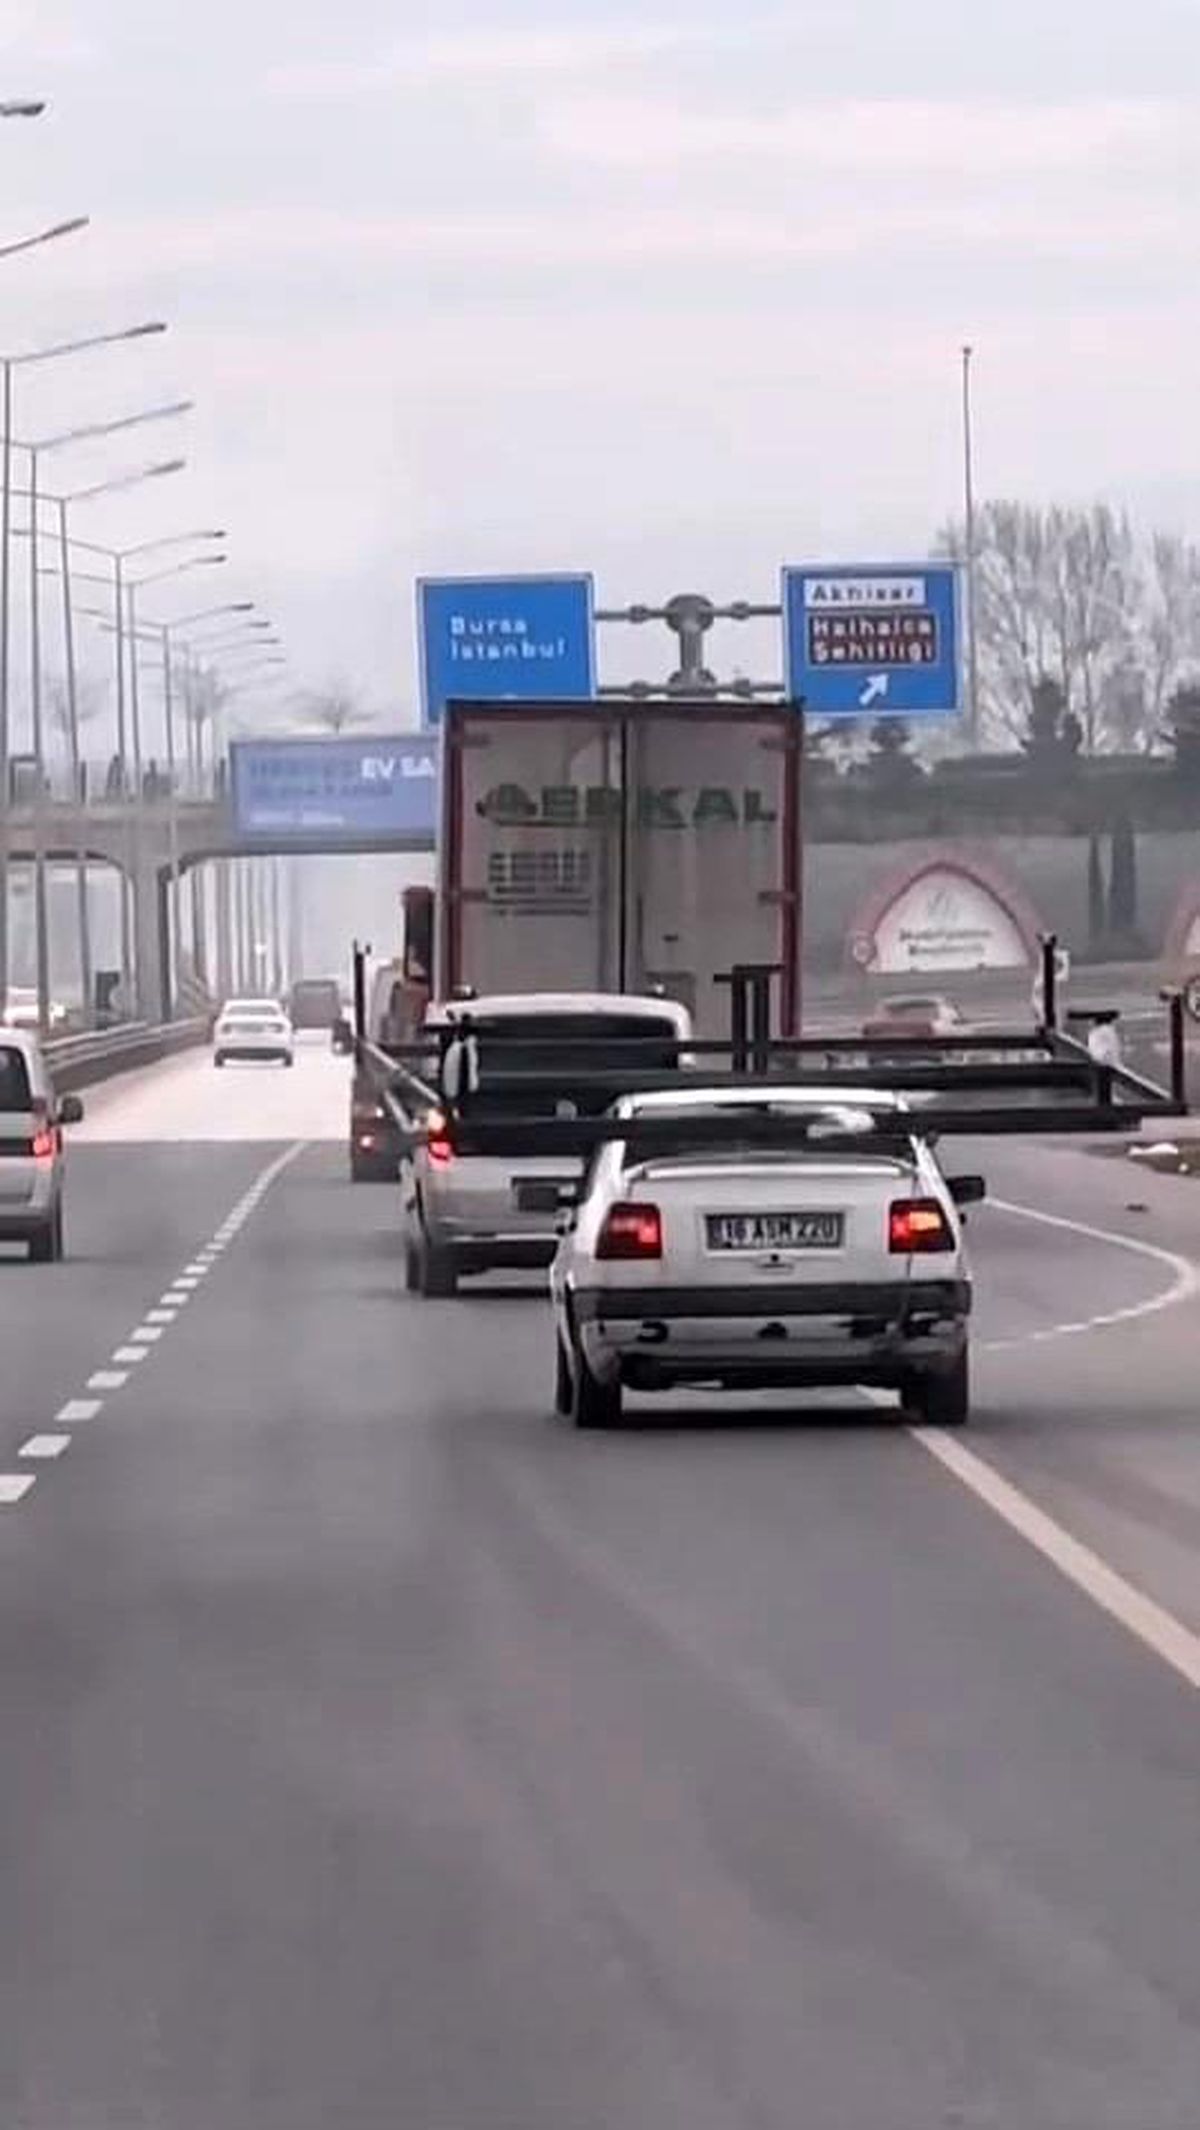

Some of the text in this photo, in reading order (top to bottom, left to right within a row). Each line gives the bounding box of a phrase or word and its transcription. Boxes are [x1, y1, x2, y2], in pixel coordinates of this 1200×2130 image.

[450, 616, 527, 636] Bursa
[813, 614, 933, 637] Halhalca
[360, 756, 395, 779] EV
